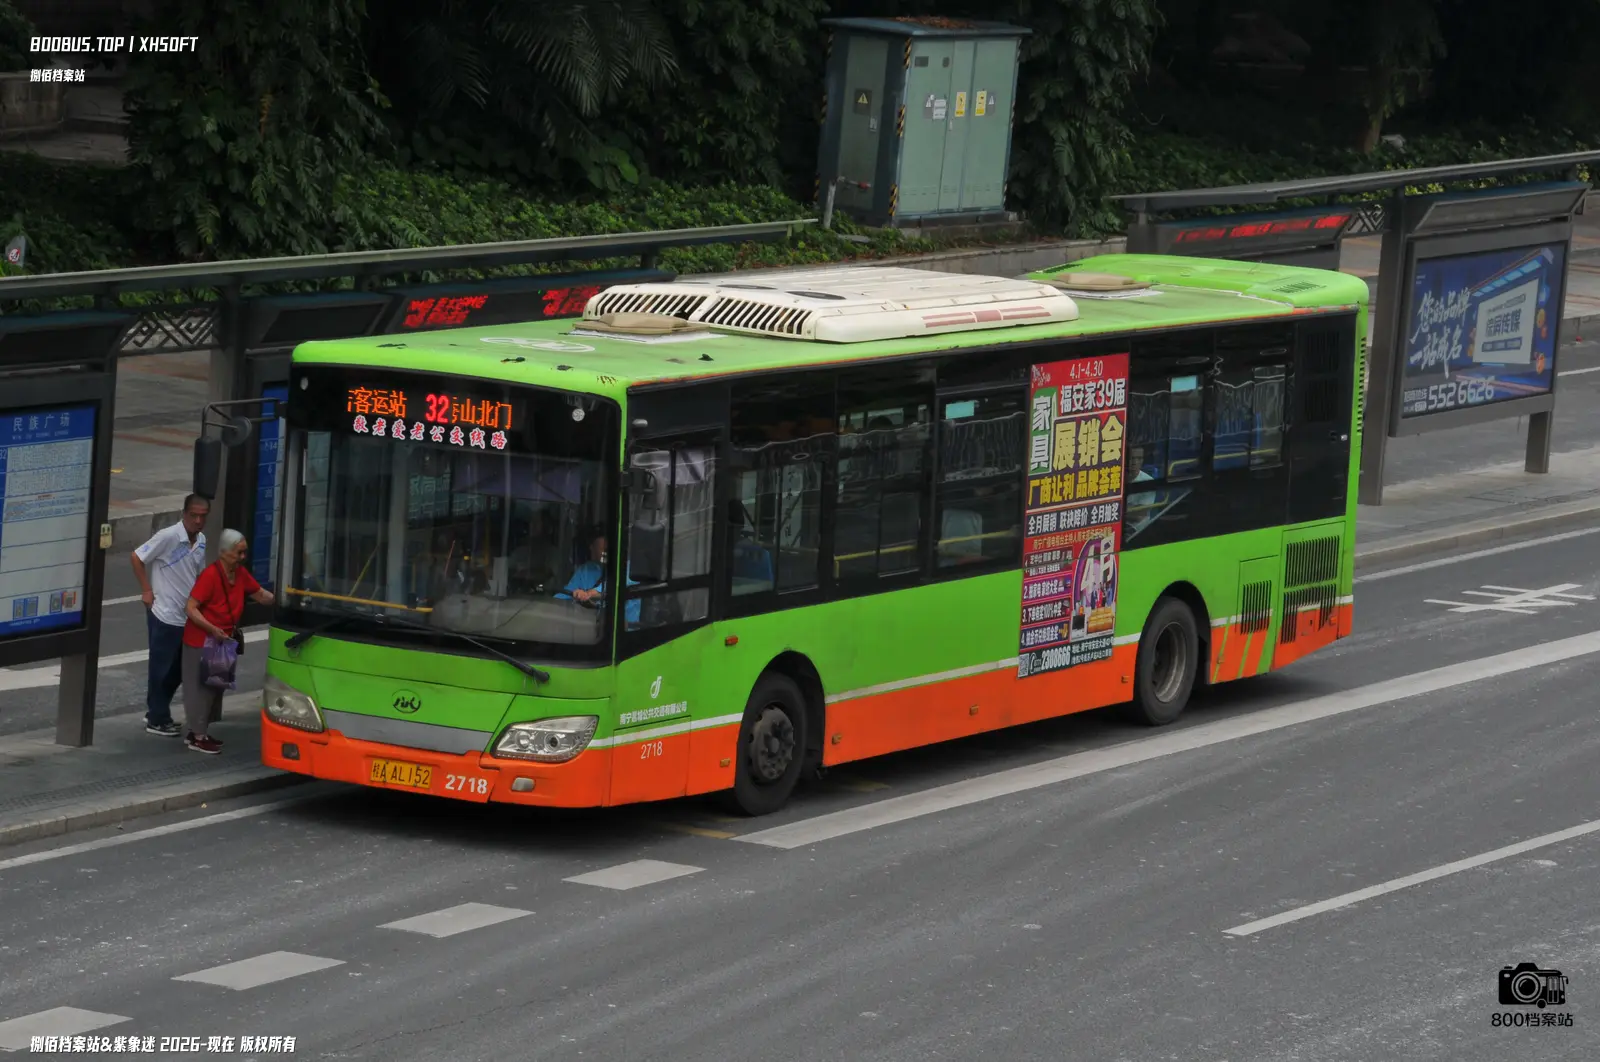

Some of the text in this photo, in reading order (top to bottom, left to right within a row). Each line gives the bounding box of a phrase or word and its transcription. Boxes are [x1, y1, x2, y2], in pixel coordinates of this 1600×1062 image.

[1069, 360, 1104, 379] 4.1-4.30
[13, 413, 70, 432] 民族广场
[425, 393, 449, 424] 32
[353, 415, 507, 449] 敬老爱老公交线路
[1030, 396, 1050, 470] 家具
[1052, 415, 1123, 472] 展销会
[1028, 465, 1121, 506] 厂商让利 品牌荟萃
[640, 741, 663, 760] 2718
[445, 774, 488, 795] 2718
